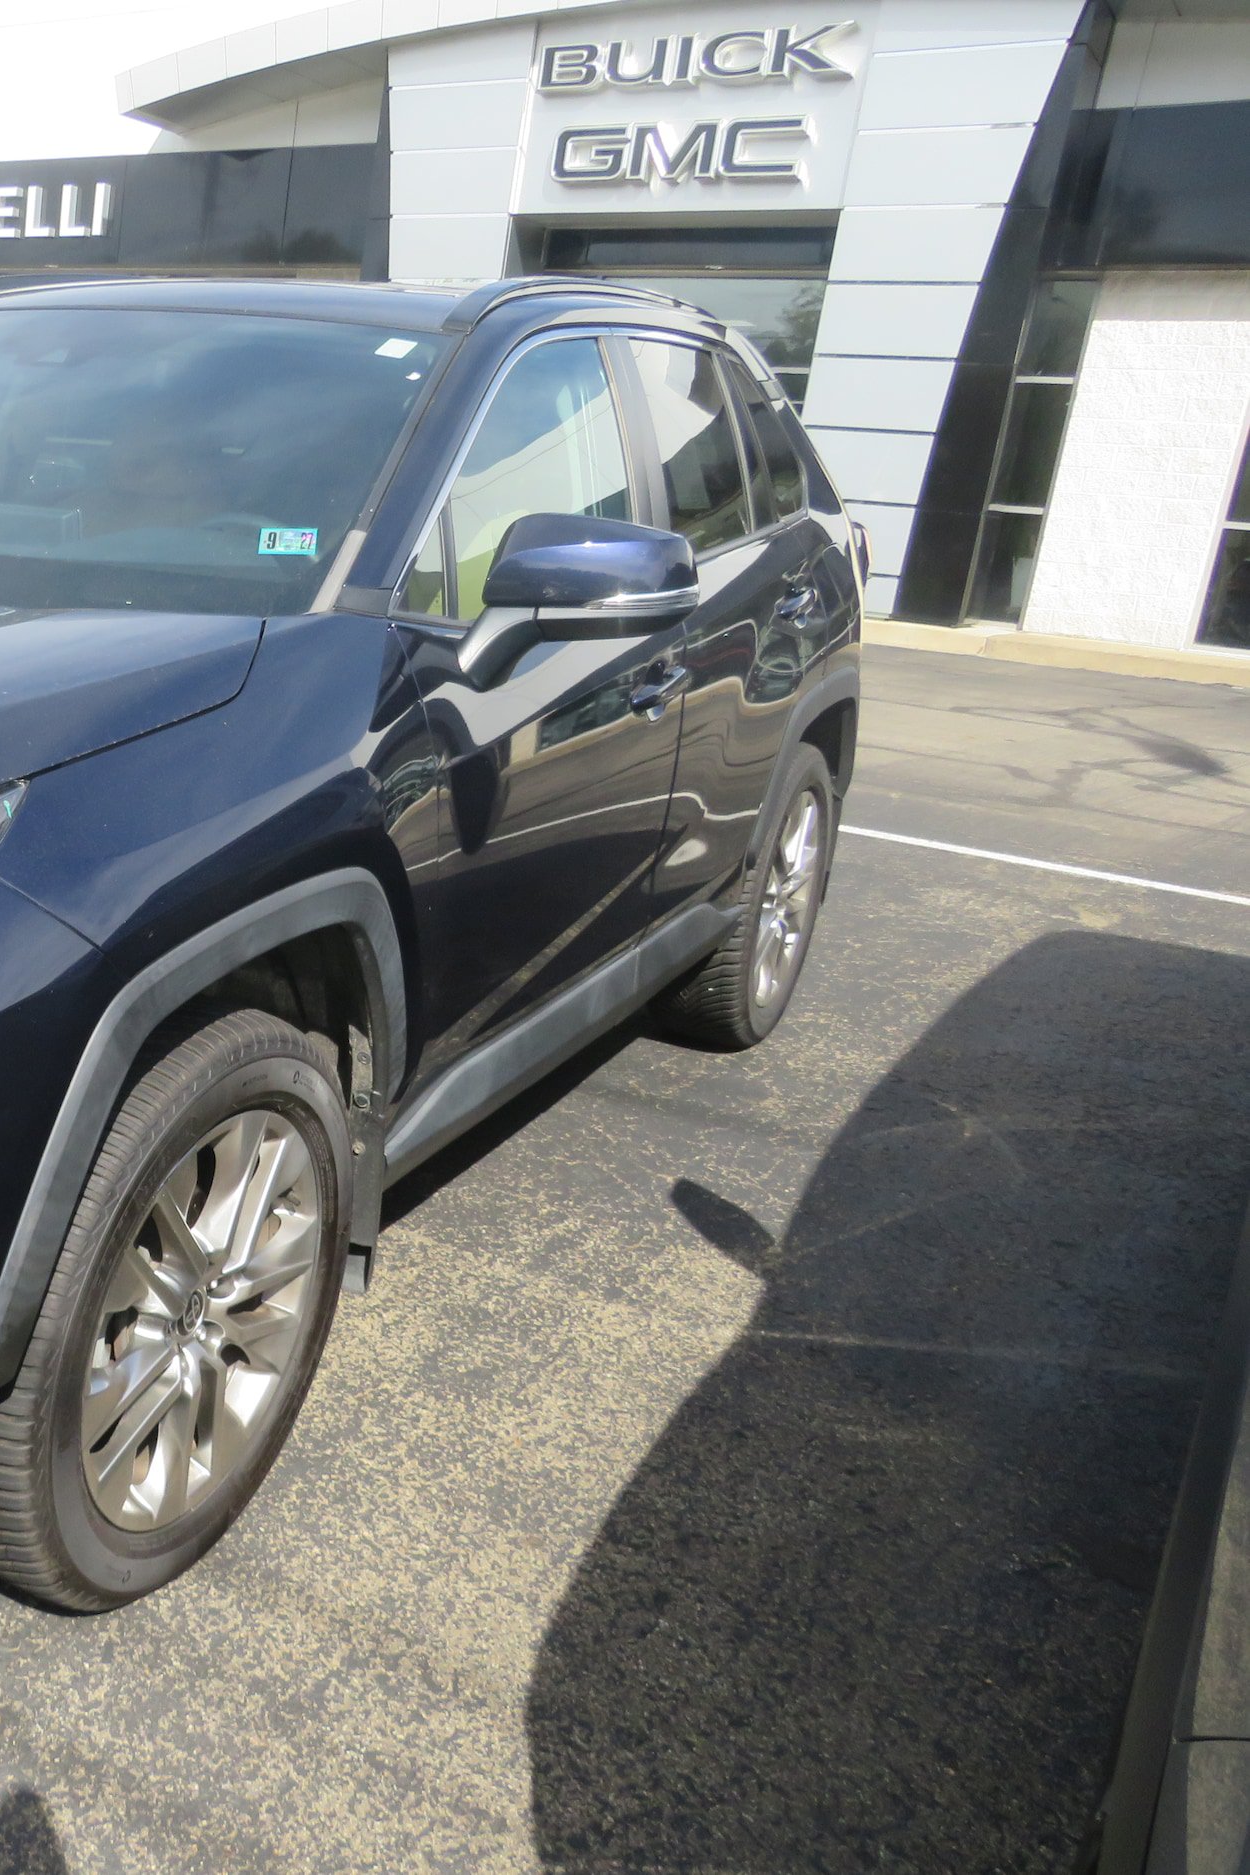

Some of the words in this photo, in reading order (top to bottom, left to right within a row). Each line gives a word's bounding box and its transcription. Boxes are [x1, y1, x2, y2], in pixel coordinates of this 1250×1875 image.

[536, 20, 856, 93] BUICK
[550, 115, 813, 183] GMC
[267, 531, 277, 549] 9
